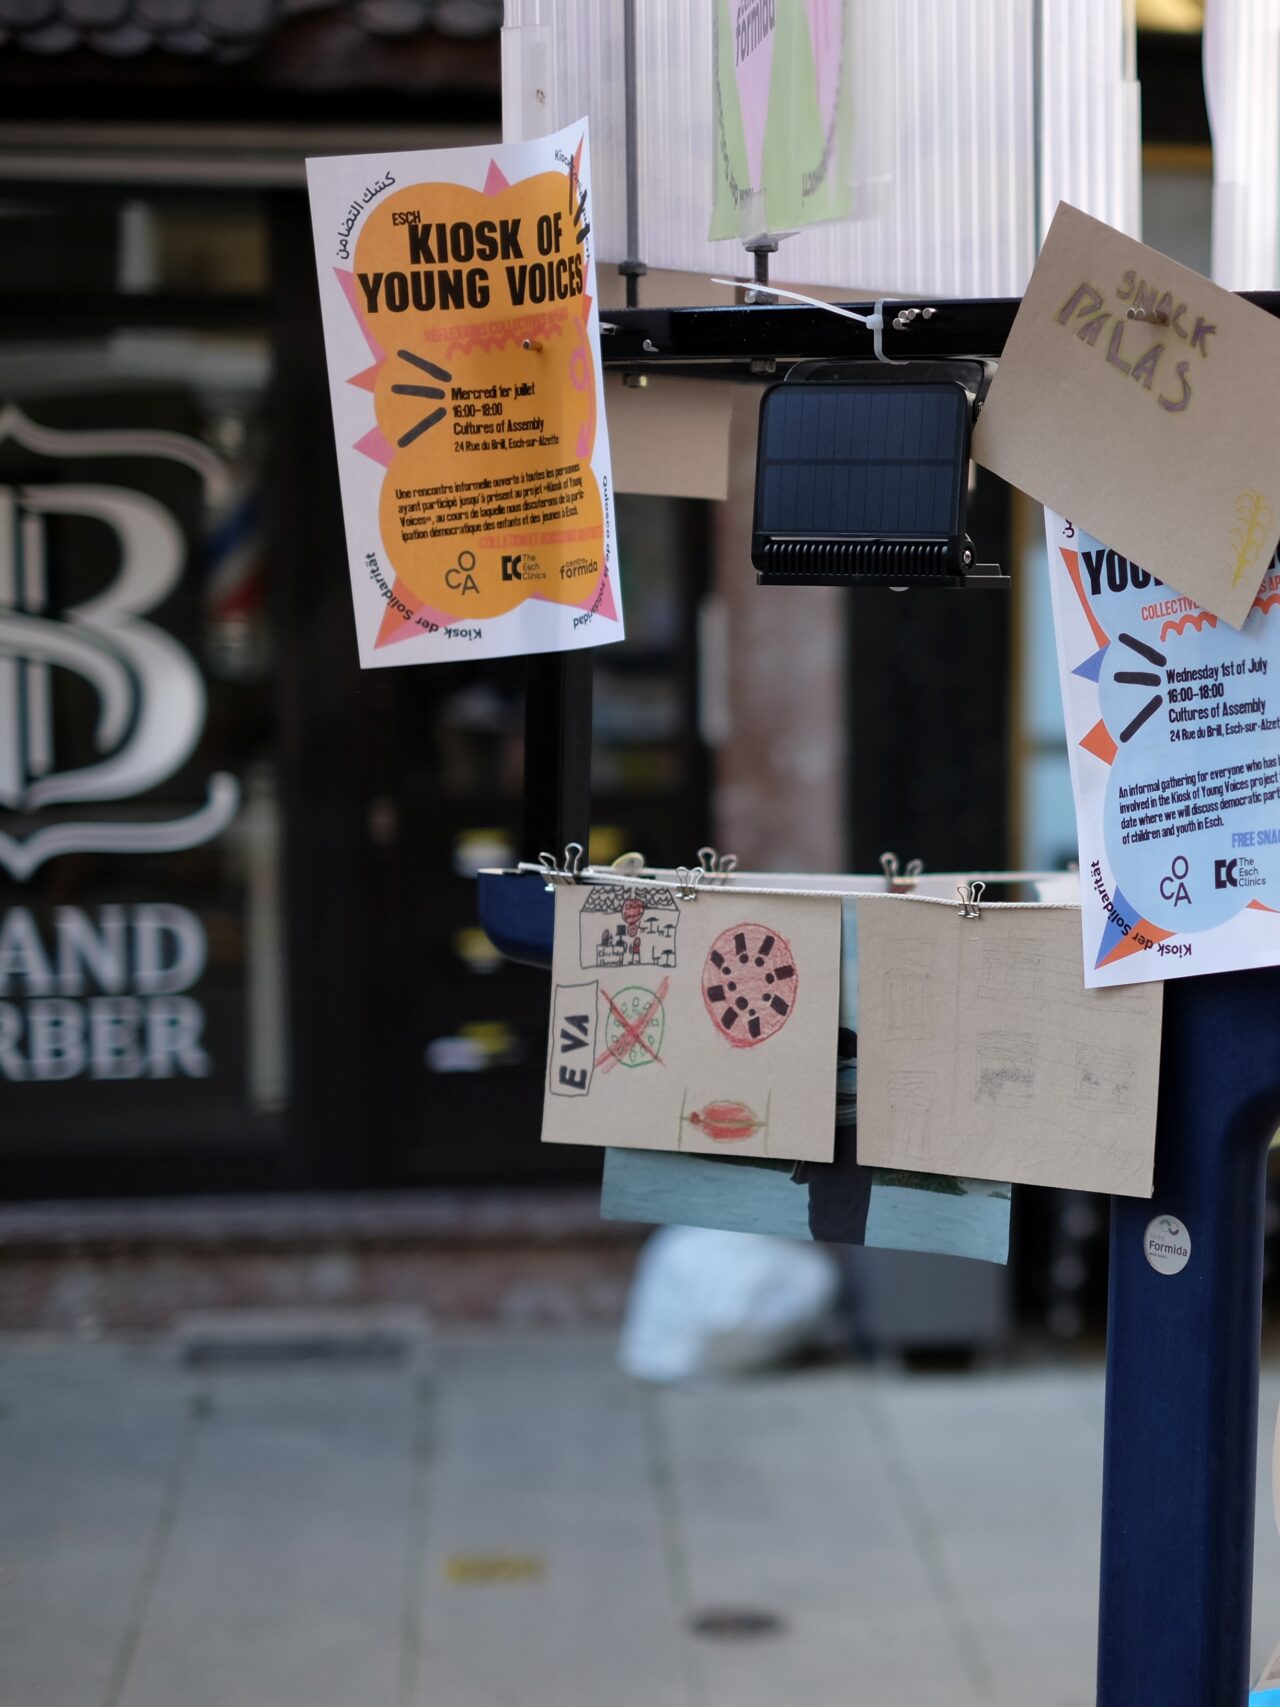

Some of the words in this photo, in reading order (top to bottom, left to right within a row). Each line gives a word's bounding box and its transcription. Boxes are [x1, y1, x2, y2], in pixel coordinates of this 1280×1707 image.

[363, 170, 397, 204] كشك
[392, 210, 421, 226] ESCH
[336, 200, 365, 260] التضامن
[408, 218, 524, 265] KIOSK
[536, 211, 563, 257] OF
[357, 268, 491, 314] YOUNG
[505, 252, 584, 307] VOICES
[1053, 280, 1194, 414] PALAS
[451, 385, 497, 401] Mercredi
[453, 422, 494, 436] Cultures
[496, 419, 505, 433] of
[507, 416, 545, 434] Assembly
[454, 441, 465, 452] 24
[465, 440, 480, 451] Rue
[481, 439, 490, 451] du
[395, 489, 412, 500] Une
[412, 483, 454, 498] rencontre
[454, 478, 492, 493] informelle
[493, 474, 519, 487] ouverte
[398, 500, 421, 515] ayant
[523, 484, 542, 499] projet
[435, 514, 445, 523] au
[446, 511, 469, 521] cours
[470, 508, 479, 519] de
[506, 502, 521, 513] nous
[430, 523, 482, 538] démocratique
[483, 520, 495, 531] des
[496, 517, 521, 529] enfants
[522, 554, 536, 562] The
[522, 562, 540, 571] Esch
[559, 557, 598, 580] formida
[522, 571, 546, 580] Clinics
[365, 552, 414, 621] Solidarität
[415, 617, 439, 633] der
[443, 627, 482, 641] Kiosk
[1166, 664, 1219, 684] Wednesday
[1220, 661, 1235, 677] 1st
[1236, 659, 1246, 674] of
[1248, 657, 1268, 676] July
[1168, 706, 1209, 723] Cultures
[1210, 702, 1221, 718] of
[1222, 697, 1266, 717] Assembly
[1170, 729, 1181, 742] 24
[1181, 728, 1196, 741] Rue
[1196, 726, 1206, 739] du
[1206, 724, 1225, 738] Brill,
[1118, 786, 1128, 799] An
[1128, 779, 1160, 797] informal
[1161, 772, 1197, 793] gathering
[1197, 770, 1209, 783] for
[1209, 764, 1245, 782] everyone
[1245, 758, 1263, 773] who
[1263, 755, 1277, 769] has
[1119, 798, 1150, 815] involved
[1150, 796, 1157, 809] in
[1158, 793, 1170, 807] the
[1170, 789, 1191, 804] Kiosk
[1192, 787, 1200, 800] of
[1200, 783, 1224, 800] Young
[1224, 779, 1249, 794] Voices
[1249, 772, 1279, 791] project
[1120, 816, 1138, 830] date
[1138, 810, 1164, 827] where
[1164, 809, 1177, 821] we
[1177, 804, 1191, 819] will
[1191, 800, 1219, 816] discuss
[1219, 791, 1262, 810] democratic
[1122, 832, 1131, 845] of
[1131, 825, 1161, 843] children
[1161, 823, 1175, 837] and
[1175, 819, 1197, 838] youth
[1197, 818, 1204, 831] in
[1204, 815, 1224, 829] Esch.
[1231, 831, 1256, 848] FREE
[1238, 857, 1255, 866] The
[1239, 867, 1259, 876] Esch
[1238, 876, 1267, 887] Clinics
[1090, 859, 1132, 936] Solidarität
[1132, 932, 1154, 951] der
[1157, 943, 1192, 958] Kiosk
[1148, 1240, 1188, 1257] Formida
